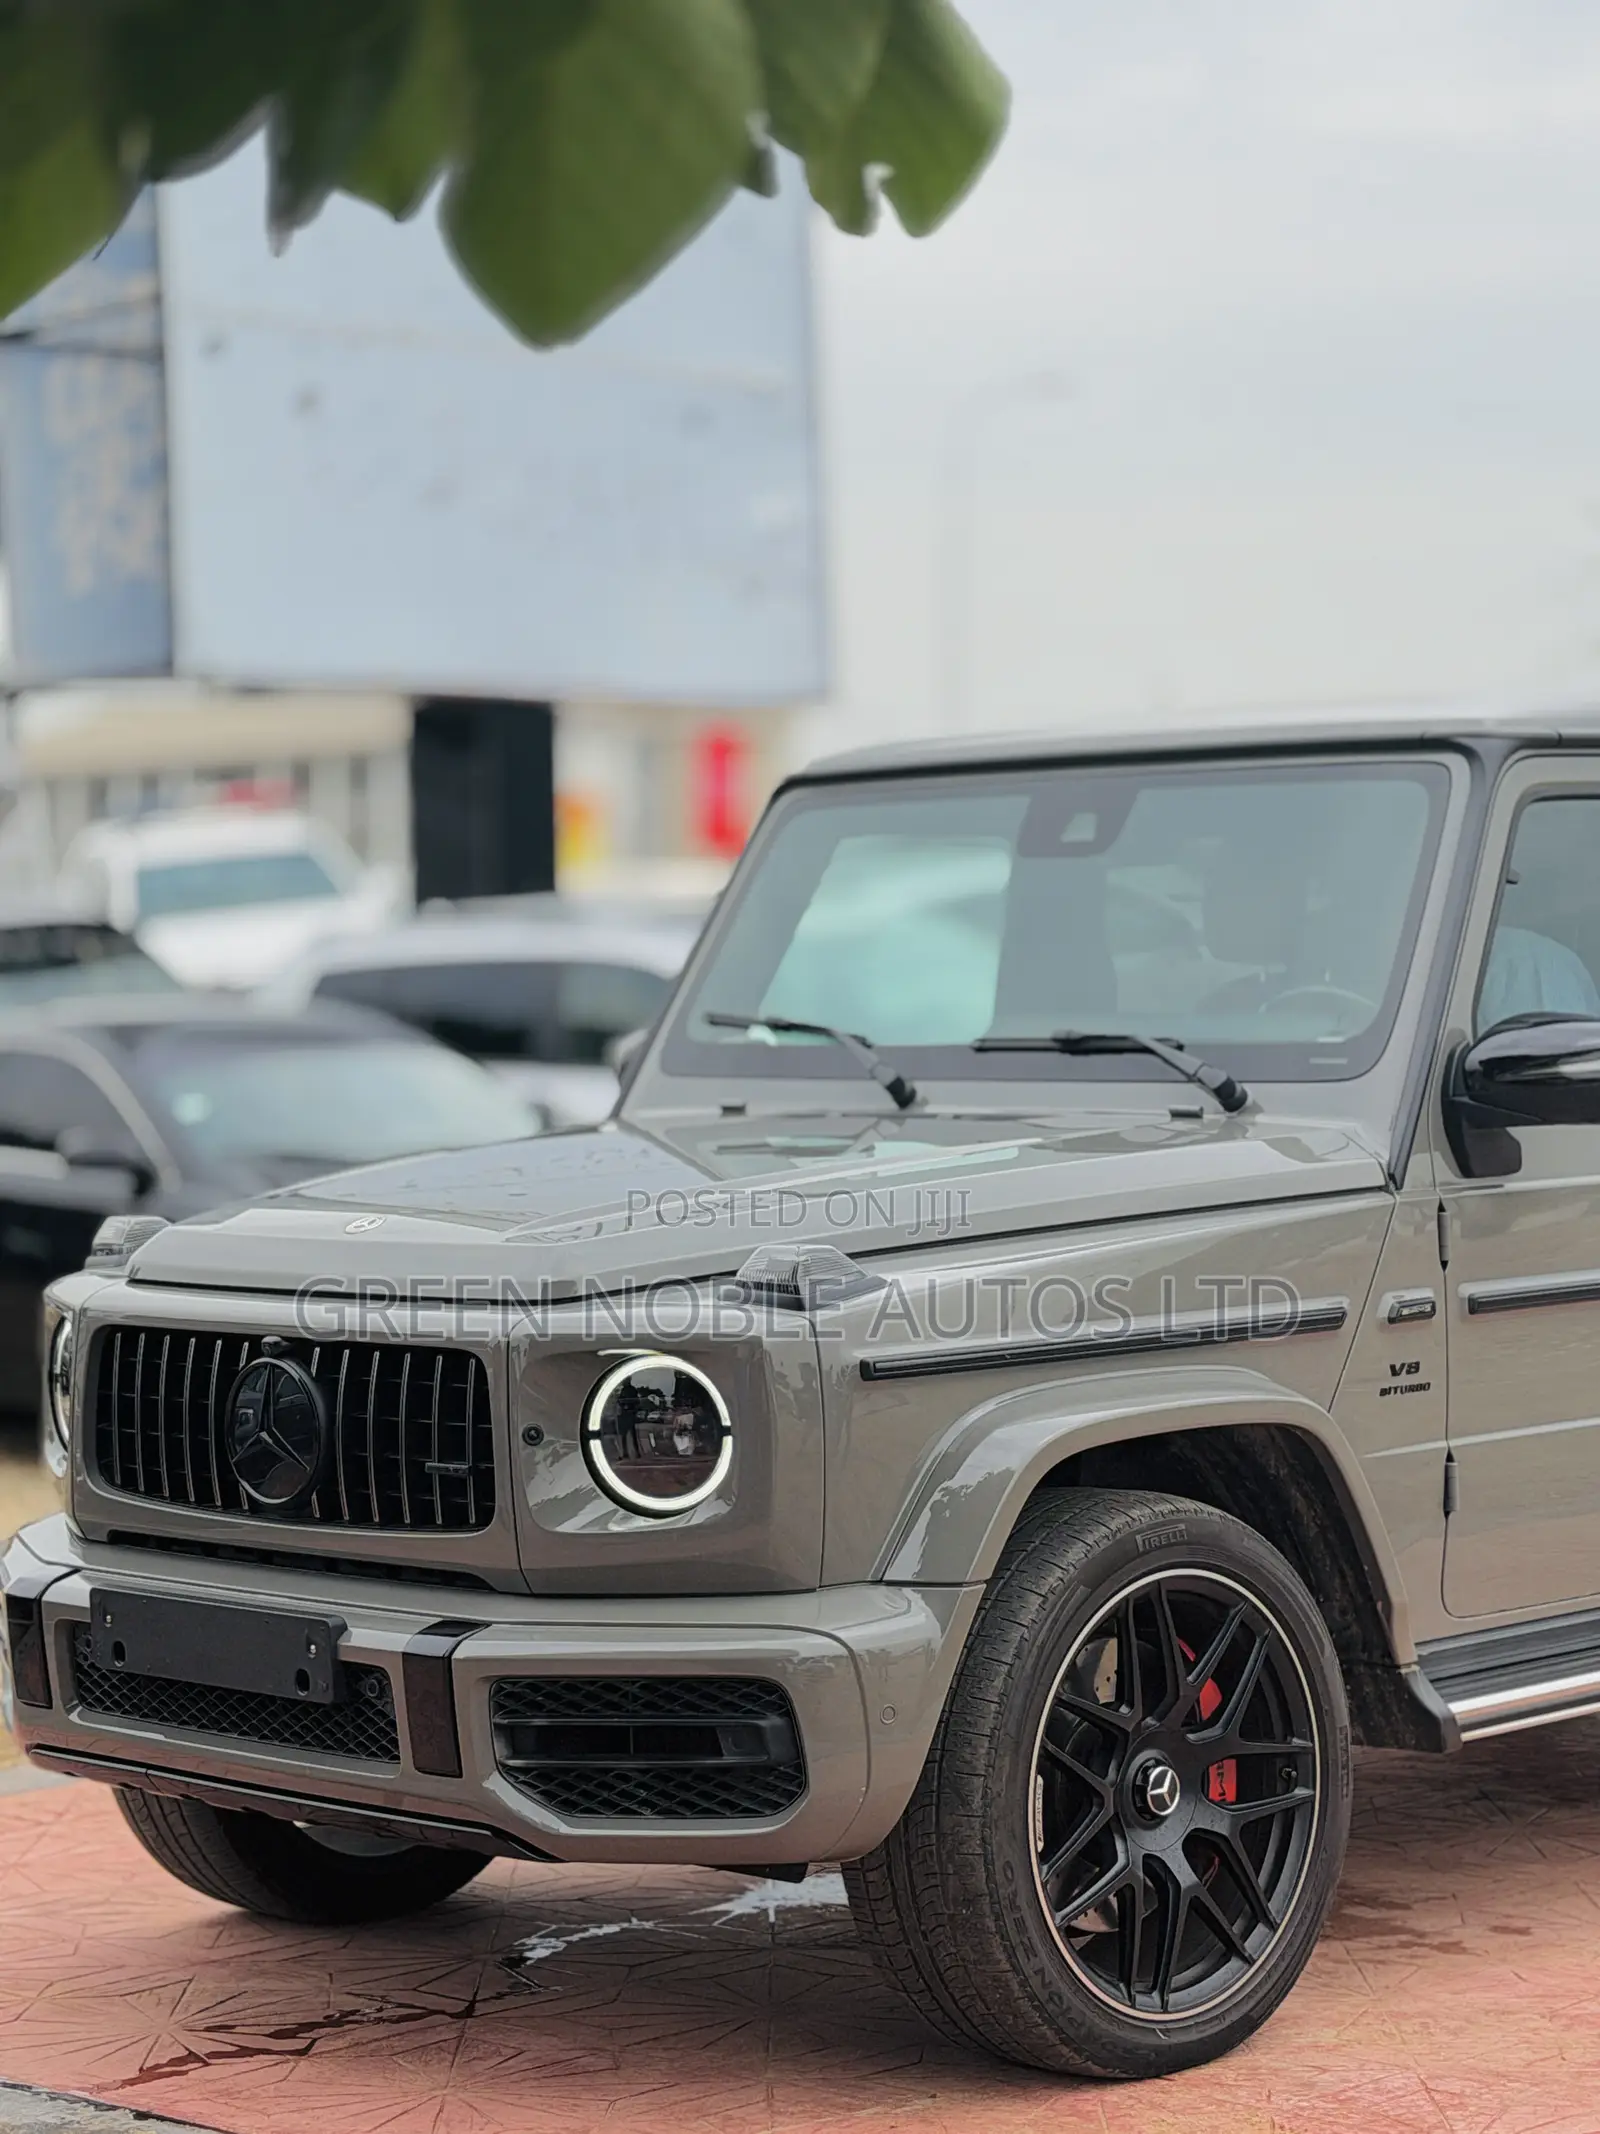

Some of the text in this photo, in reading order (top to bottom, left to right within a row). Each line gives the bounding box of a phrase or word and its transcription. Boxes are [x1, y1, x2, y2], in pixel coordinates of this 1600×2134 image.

[1389, 1361, 1420, 1377] V8
[1379, 1382, 1431, 1397] BITURBO
[1136, 1523, 1188, 1552] PIRELLI
